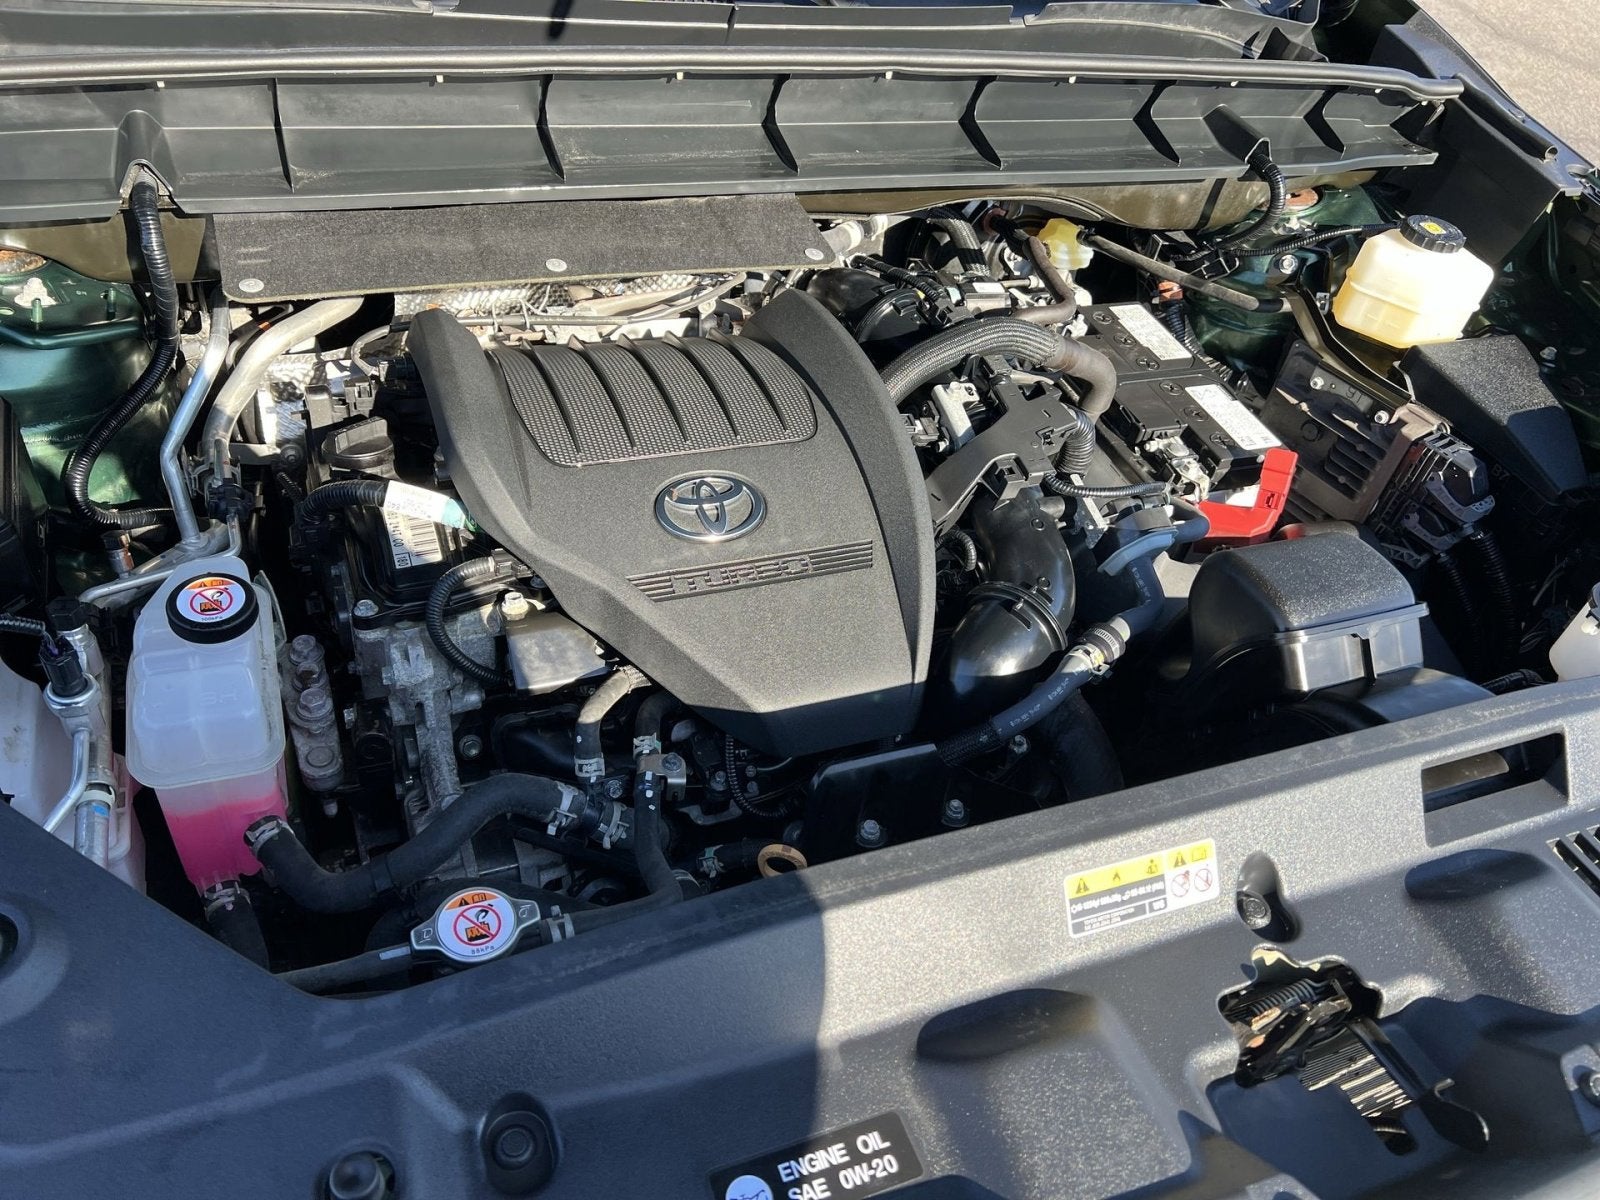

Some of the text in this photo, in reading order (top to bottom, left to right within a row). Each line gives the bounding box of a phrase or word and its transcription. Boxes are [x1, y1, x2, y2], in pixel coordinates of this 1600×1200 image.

[674, 555, 810, 591] TURBO
[777, 1130, 892, 1183] ENGINE OIL
[788, 1153, 900, 1200] SAE 0W-20
